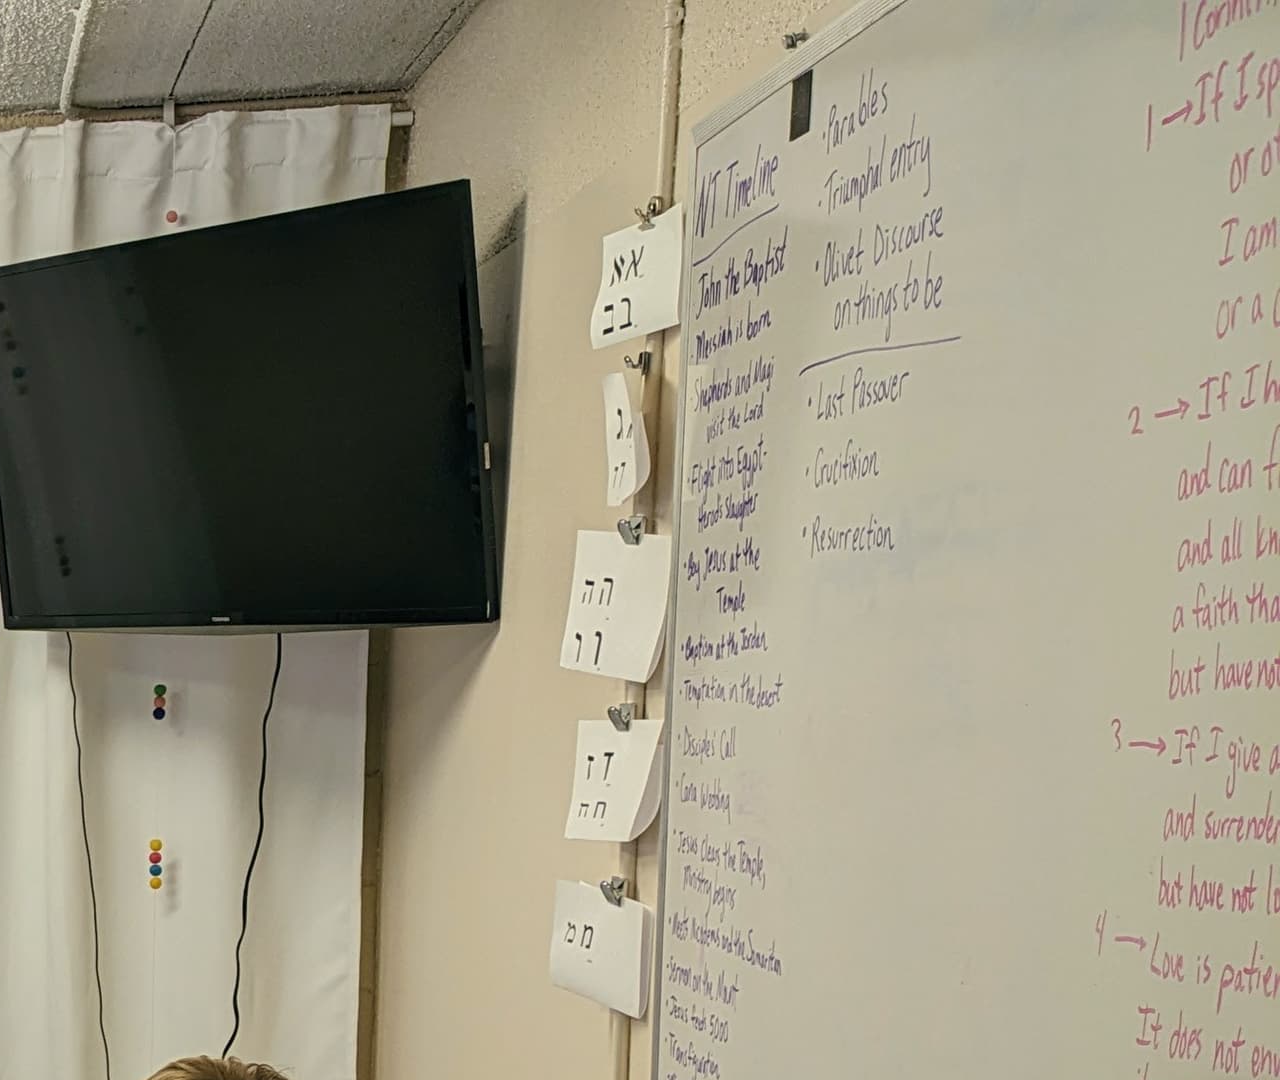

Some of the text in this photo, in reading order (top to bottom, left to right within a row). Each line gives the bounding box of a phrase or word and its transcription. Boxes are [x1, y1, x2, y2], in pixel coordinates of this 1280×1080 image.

[825, 68, 888, 154] Parables
[1194, 60, 1229, 125] If
[1233, 51, 1255, 111] I
[695, 143, 779, 238] NT Timeline
[824, 112, 931, 215] Triumphal entry
[1229, 147, 1255, 193] or
[823, 206, 944, 287] Olivet Discourse
[1218, 216, 1278, 267] I am
[696, 224, 788, 320] John the Baptist
[833, 250, 944, 343] on things to be
[696, 300, 772, 366] Messiah is born
[1216, 295, 1243, 340] or
[1251, 292, 1264, 325] a
[694, 354, 774, 414] Shepherds and Magi
[817, 366, 910, 421] Last Passover
[1127, 405, 1144, 435] 2
[1197, 371, 1232, 420] If
[1241, 364, 1261, 409] I
[706, 391, 765, 444] visit the Lord
[691, 455, 716, 502] Flight
[718, 445, 735, 485] into
[814, 438, 880, 488] Crucifixion
[1177, 440, 1212, 501] and
[1218, 457, 1252, 494] can
[687, 536, 760, 592] Boy Jesus at the
[811, 513, 895, 559] Resurrection
[1177, 517, 1213, 573] and
[1221, 515, 1243, 566] all
[716, 578, 746, 622] Temple
[1172, 605, 1184, 633] a
[1192, 581, 1240, 631] faith
[685, 620, 769, 668] Baptism at the Jordan
[1168, 647, 1206, 701] but
[1214, 641, 1253, 690] have
[683, 675, 726, 710] Temptation
[728, 681, 738, 703] in
[740, 672, 756, 706] the
[1111, 717, 1122, 753] 3
[1172, 725, 1200, 766] If
[1204, 726, 1224, 763] I
[1225, 735, 1262, 800] give
[1163, 791, 1197, 842] and
[677, 831, 698, 856] Jesus
[722, 841, 736, 873] the
[1157, 855, 1185, 909] but
[1189, 864, 1225, 912] have
[1231, 868, 1258, 914] not
[1095, 908, 1108, 957] 4
[1149, 931, 1185, 983] Love
[1196, 954, 1212, 985] is
[669, 995, 689, 1025] Jesus
[1136, 1003, 1163, 1050] It
[1169, 1009, 1203, 1060] does
[1212, 1025, 1246, 1074] not
